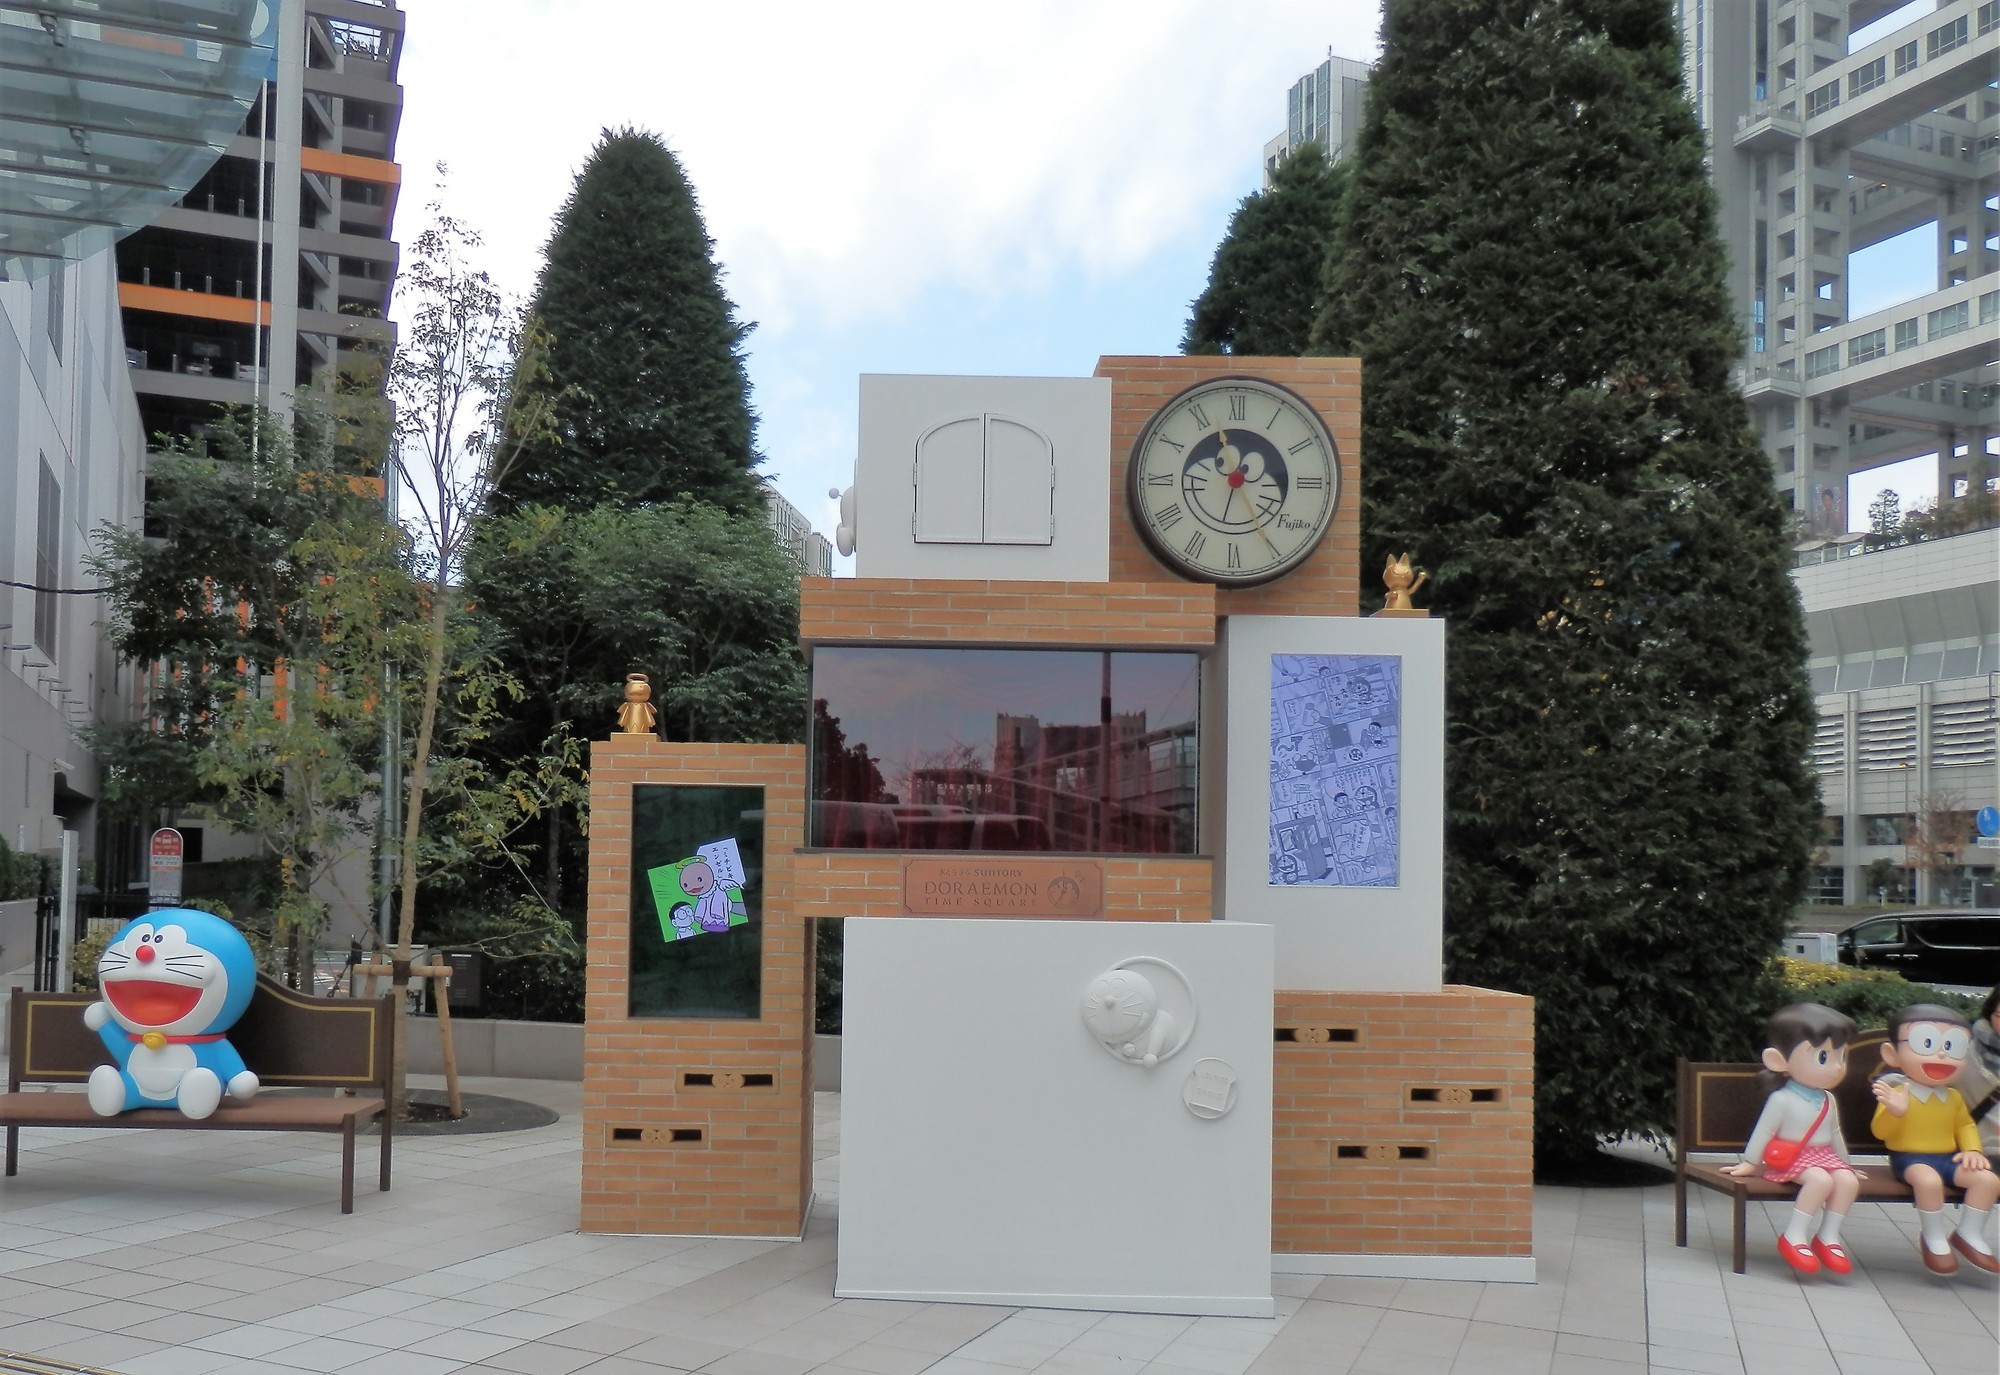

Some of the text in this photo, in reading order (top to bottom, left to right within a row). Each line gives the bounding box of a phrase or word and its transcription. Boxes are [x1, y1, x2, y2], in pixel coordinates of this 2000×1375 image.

[1188, 403, 1210, 431] XI
[1229, 395, 1246, 421] XII
[1159, 433, 1185, 453] X
[1276, 513, 1311, 531] Fujiko
[973, 868, 1023, 878] SUNTORY
[924, 881, 1038, 896] DORAEMON
[924, 897, 1038, 907] TIME SQUARE
